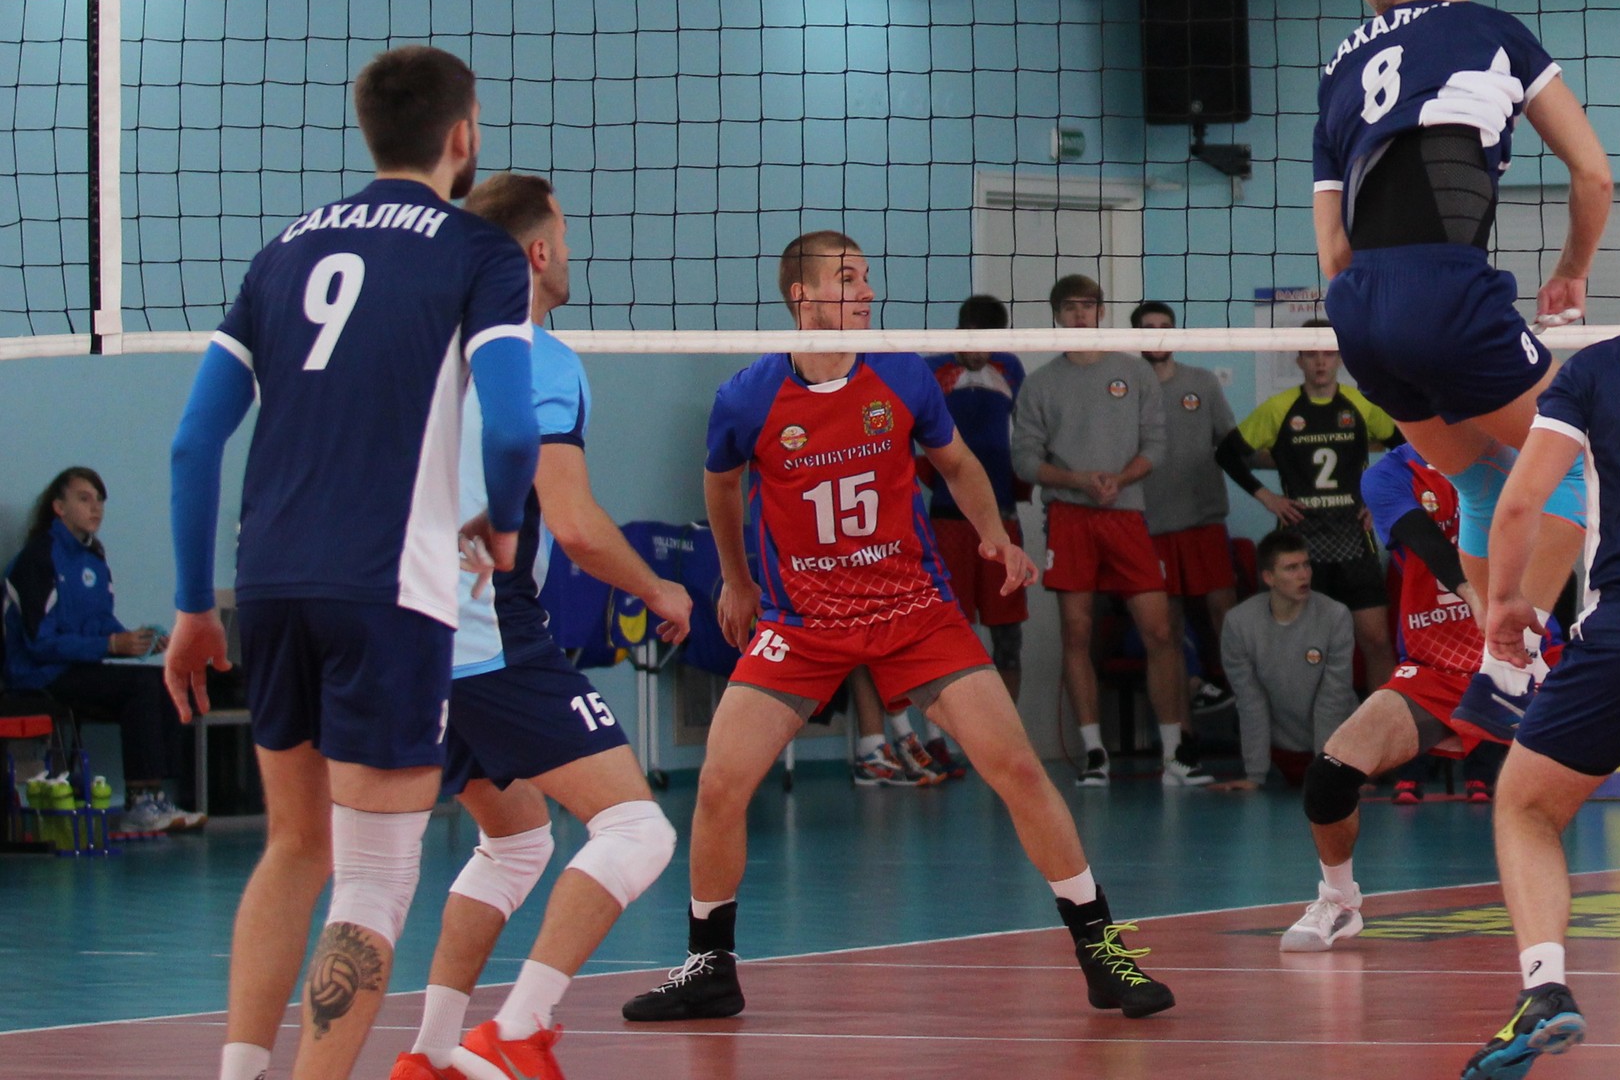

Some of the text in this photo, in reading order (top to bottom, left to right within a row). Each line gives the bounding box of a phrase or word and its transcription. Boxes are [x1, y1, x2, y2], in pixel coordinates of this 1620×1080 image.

[1360, 45, 1404, 125] 8
[281, 203, 449, 243] САХАЛИН
[303, 252, 366, 370] 9
[1520, 331, 1539, 365] 8
[783, 439, 892, 470] ОРЕНБУРЖЬЕ
[1312, 448, 1338, 489] 2
[802, 470, 879, 545] 15
[790, 539, 903, 572] НЕФТЯНИК
[750, 628, 790, 662] 15
[570, 692, 616, 732] 15
